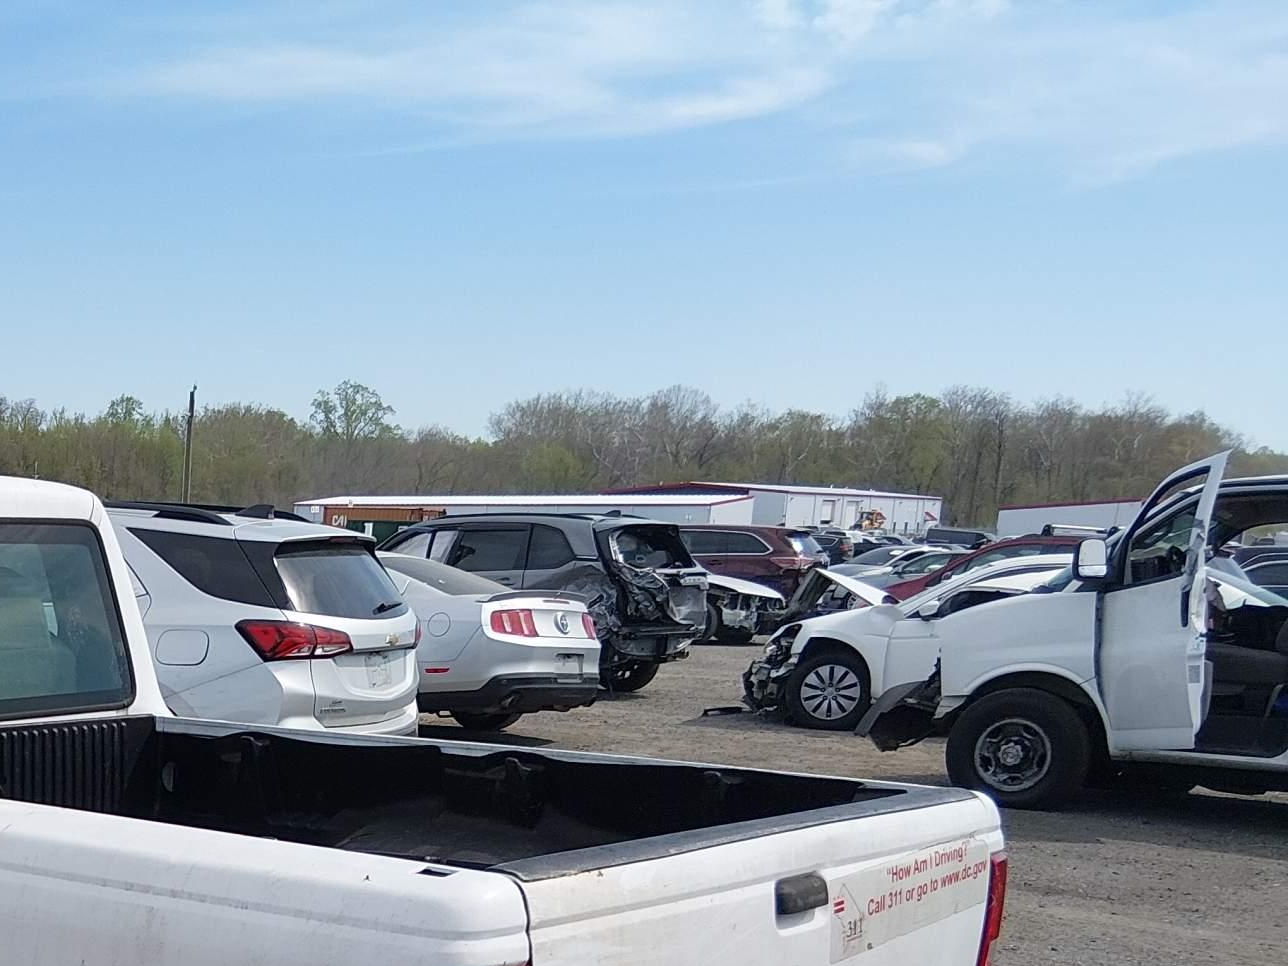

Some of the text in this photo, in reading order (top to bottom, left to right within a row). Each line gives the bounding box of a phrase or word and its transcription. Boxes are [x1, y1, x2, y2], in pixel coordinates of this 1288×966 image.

[912, 859, 928, 876] Am
[867, 859, 987, 916] Call 311 or go to www.dc.gov
[846, 918, 863, 937] 311
